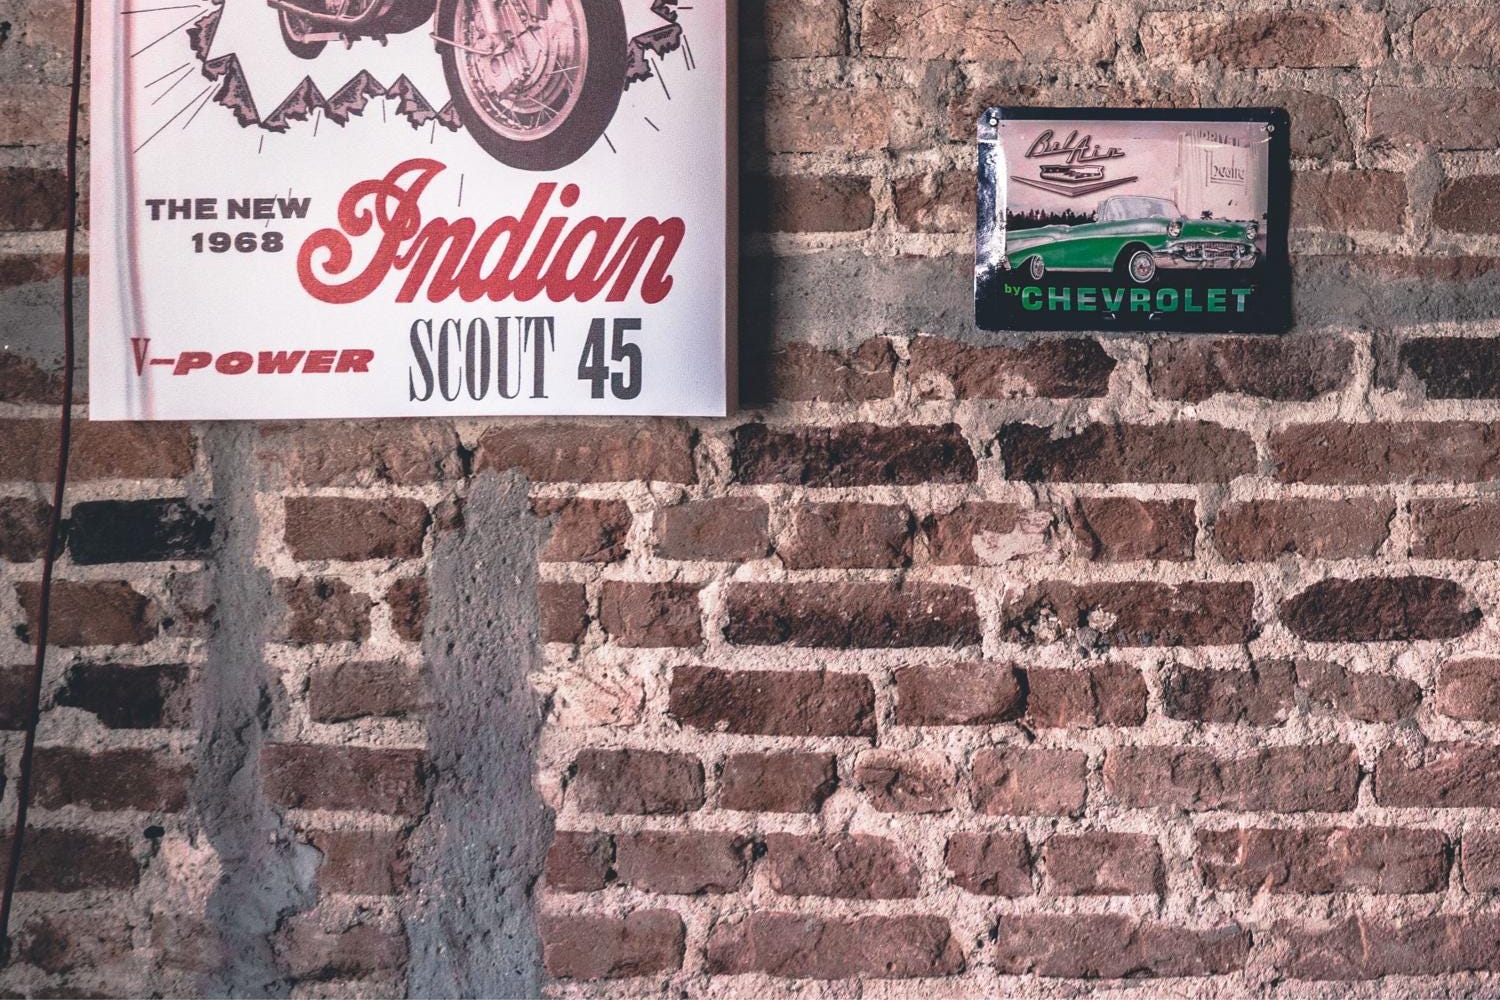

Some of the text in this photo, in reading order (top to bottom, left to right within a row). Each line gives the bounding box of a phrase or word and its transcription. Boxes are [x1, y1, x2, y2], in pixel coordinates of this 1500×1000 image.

[1024, 128, 1126, 164] Bel Air
[145, 198, 312, 221] THE NEW
[191, 231, 285, 254] 1968
[296, 157, 686, 306] Indian
[1004, 283, 1252, 313] by CHEVROLET
[130, 337, 375, 378] V-POWER
[409, 316, 643, 404] SCOUT 45
